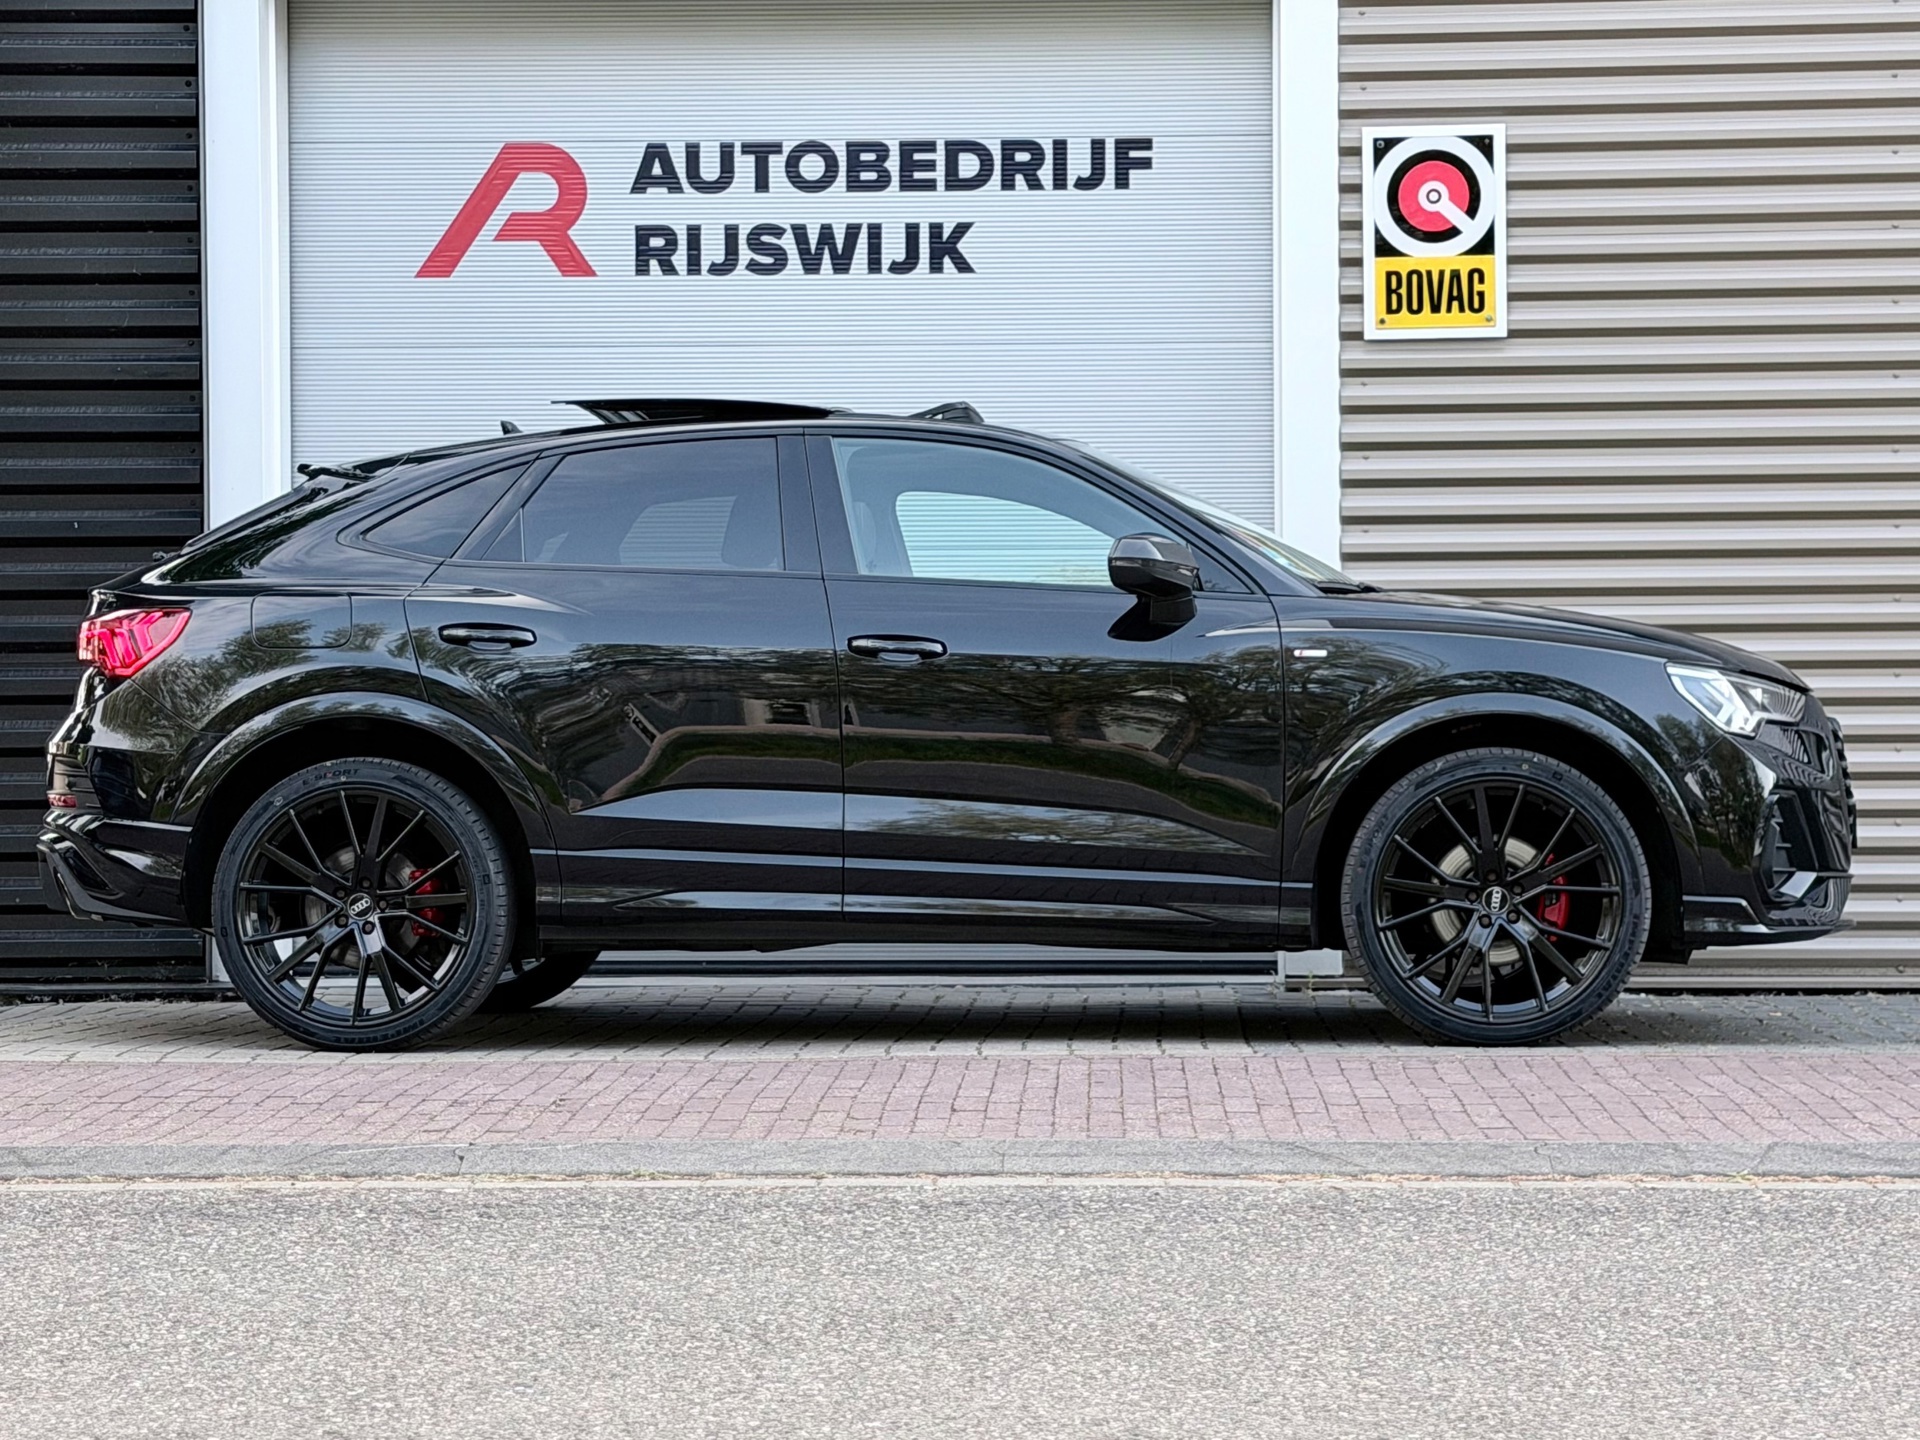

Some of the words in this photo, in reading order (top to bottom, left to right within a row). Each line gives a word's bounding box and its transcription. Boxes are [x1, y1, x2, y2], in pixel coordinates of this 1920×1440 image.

[629, 137, 1153, 194] AUTOBEDRIJF
[634, 222, 976, 276] RIJSWIJK
[1385, 267, 1485, 315] BOVAG
